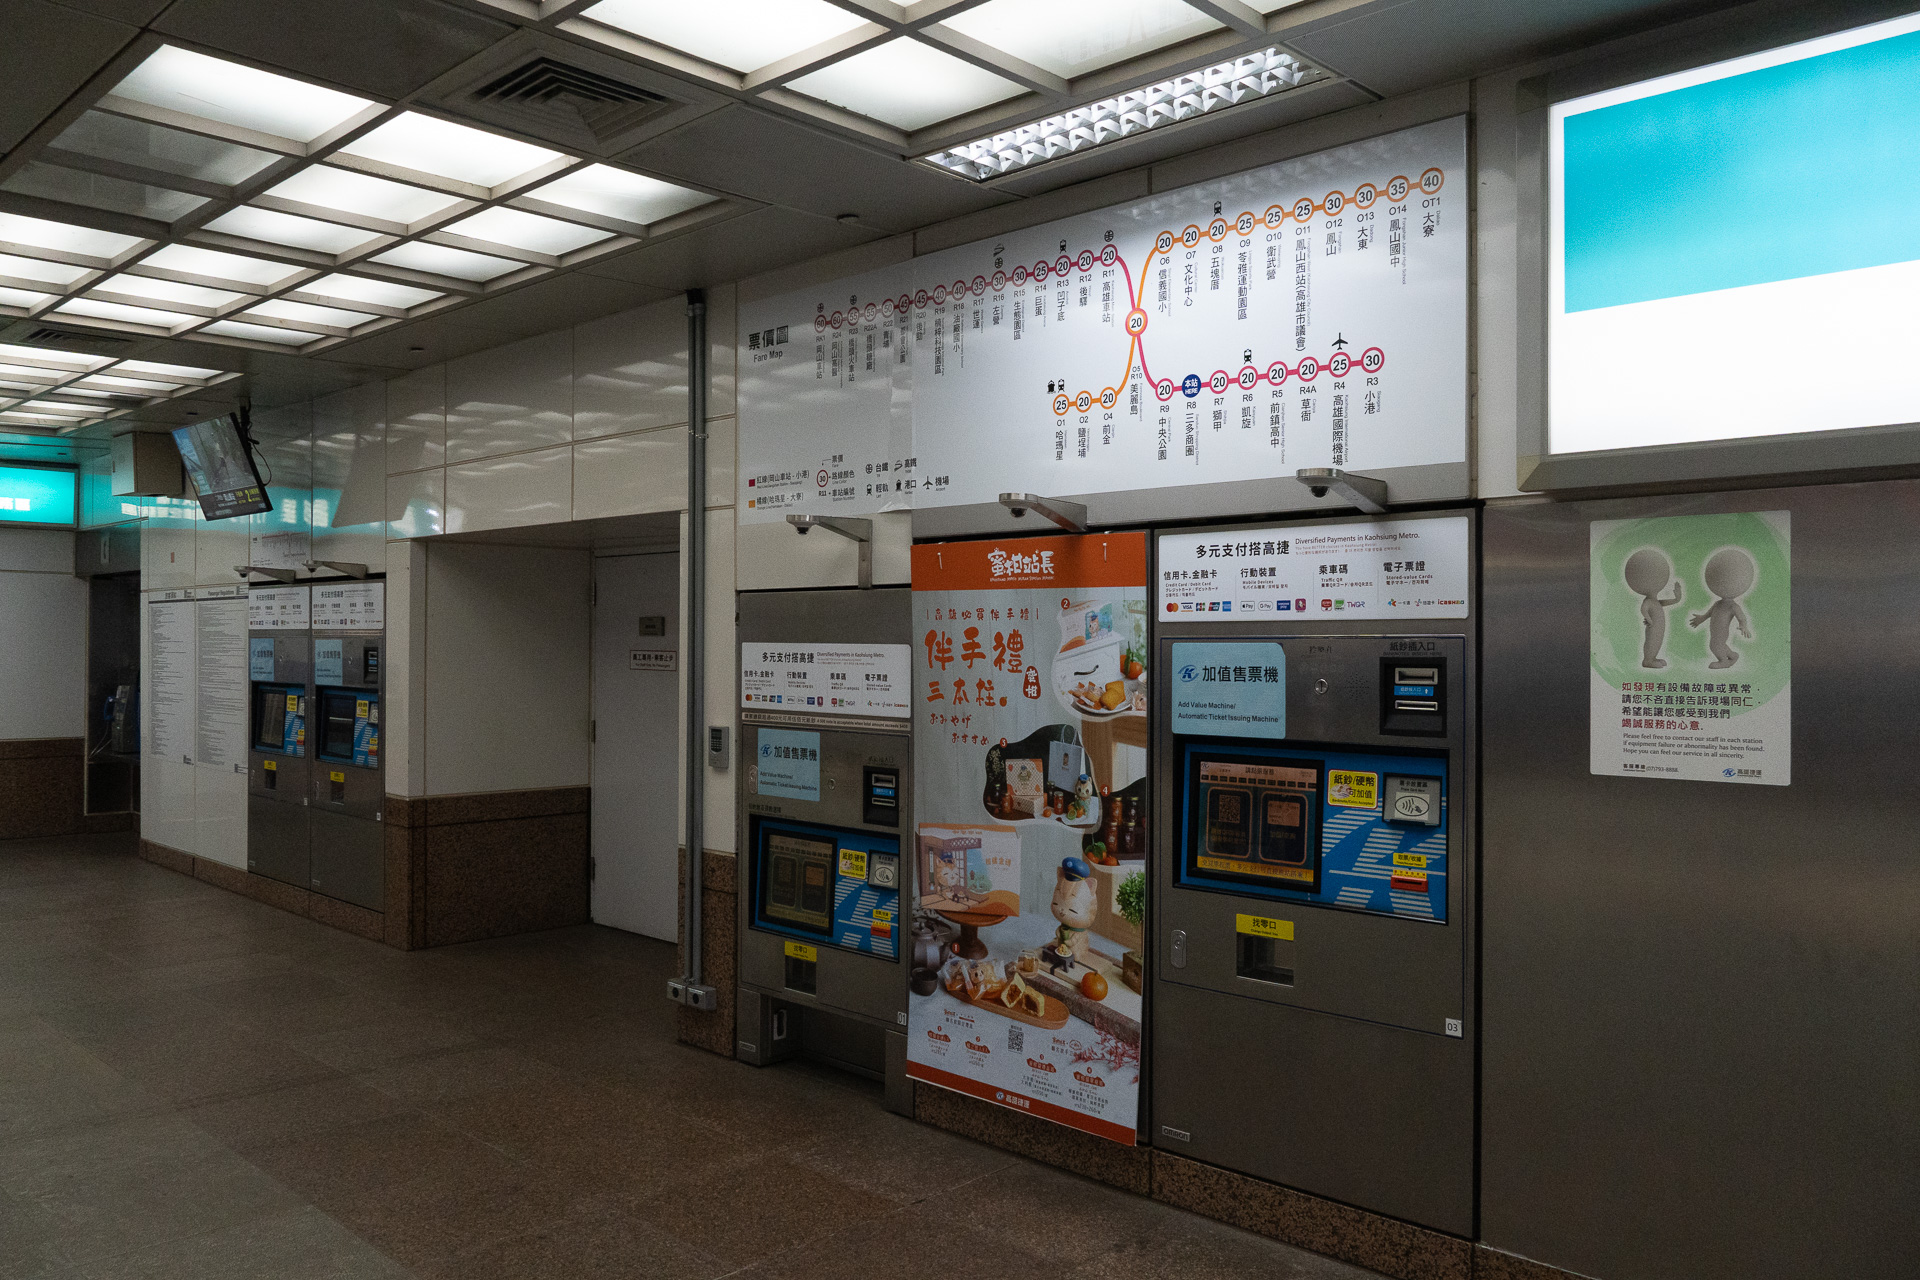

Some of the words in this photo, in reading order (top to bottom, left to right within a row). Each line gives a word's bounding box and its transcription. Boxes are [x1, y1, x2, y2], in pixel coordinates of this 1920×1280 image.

[1424, 174, 1439, 188] 40
[1391, 182, 1406, 196] 35
[1358, 190, 1372, 204] 30
[1422, 197, 1441, 208] OT1
[1327, 197, 1341, 211] 30
[1296, 204, 1310, 217] 25
[1389, 204, 1407, 216] O14
[1267, 211, 1280, 224] 25
[1357, 212, 1374, 222] O13
[1240, 218, 1252, 230] 25
[1326, 219, 1342, 229] O12
[1423, 212, 1434, 237] 大寮
[1212, 225, 1224, 236] 20
[1185, 231, 1197, 243] 20
[1266, 232, 1282, 242] O10
[1358, 226, 1368, 250] 大東
[1159, 237, 1171, 249] 20
[1240, 239, 1250, 248] O9
[1390, 219, 1400, 268] 鳳山國中
[1212, 245, 1223, 254] O8
[1080, 256, 1091, 266] 20
[1104, 251, 1114, 262] 20
[1160, 257, 1170, 265] O6
[1186, 251, 1196, 260] O7
[1036, 266, 1046, 276] 25
[1058, 261, 1068, 272] 20
[1014, 272, 1024, 281] 30
[1080, 274, 1092, 283] R12
[1103, 270, 1114, 278] R11
[974, 281, 984, 291] 35
[994, 276, 1004, 286] 30
[1057, 280, 1069, 288] R13
[1184, 264, 1193, 307] 文化中心
[954, 286, 964, 295] 40
[1035, 284, 1046, 293] R14
[936, 290, 944, 300] 40
[993, 294, 1004, 302] R16
[954, 303, 964, 311] R18
[973, 298, 984, 306] R17
[1102, 282, 1110, 322] 高雄車站
[1131, 317, 1142, 328] 20
[748, 325, 789, 350] 票價圖
[753, 354, 768, 362] Fare
[769, 350, 783, 360] Map
[1366, 354, 1380, 366] 30
[1302, 364, 1314, 375] 20
[1333, 359, 1346, 370] 25
[1242, 372, 1254, 384] 20
[1271, 368, 1284, 380] 20
[1184, 378, 1198, 388] 本站
[1214, 377, 1226, 388] 20
[1334, 382, 1345, 390] R4
[1366, 378, 1378, 386] R3
[1159, 385, 1170, 396] 20
[1272, 390, 1282, 398] R5
[1300, 386, 1317, 394] R4A
[1079, 396, 1089, 407] 20
[1103, 393, 1113, 404] 20
[1364, 391, 1376, 414] 小港
[1056, 400, 1066, 410] 25
[1270, 403, 1280, 448] 前鎮高中
[1332, 395, 1343, 466] 高雄國際機場
[1158, 418, 1167, 460] 中央公園
[1186, 414, 1194, 456] 三多商圈
[904, 480, 917, 489] 港口
[935, 476, 949, 486] 機場
[1295, 536, 1326, 544] Diversified
[1327, 536, 1356, 544] Payments
[1364, 533, 1397, 542] Kaohsiung
[1196, 540, 1290, 558] 多元支付搭高捷
[988, 548, 1054, 576] 蜜柑站長
[1383, 561, 1426, 572] 電子票證
[1164, 569, 1218, 580] 信用卡.金融卡
[1240, 567, 1277, 578] 行動裝置
[1319, 564, 1348, 575] 乘車碼
[936, 608, 1029, 620] 高雄必買伴手禮
[924, 627, 1024, 673] 伴手禮
[762, 652, 814, 664] 多元支付搭高捷
[1202, 666, 1278, 683] 加值售票機
[1026, 668, 1038, 697] 蜜柑
[926, 677, 996, 707] 三本柱
[1178, 712, 1207, 721] Automatic
[1228, 714, 1250, 723] Issuing
[1622, 707, 1730, 719] 希望能讓您感受到我們
[930, 713, 972, 729] おみやげ
[952, 732, 989, 746] おすすめ
[774, 746, 817, 761] 加值售票機
[1334, 774, 1375, 787] 紙鈔/硬幣
[1252, 918, 1276, 929] 找零口
[899, 1013, 905, 1024] 01
[1447, 1022, 1458, 1032] 03
